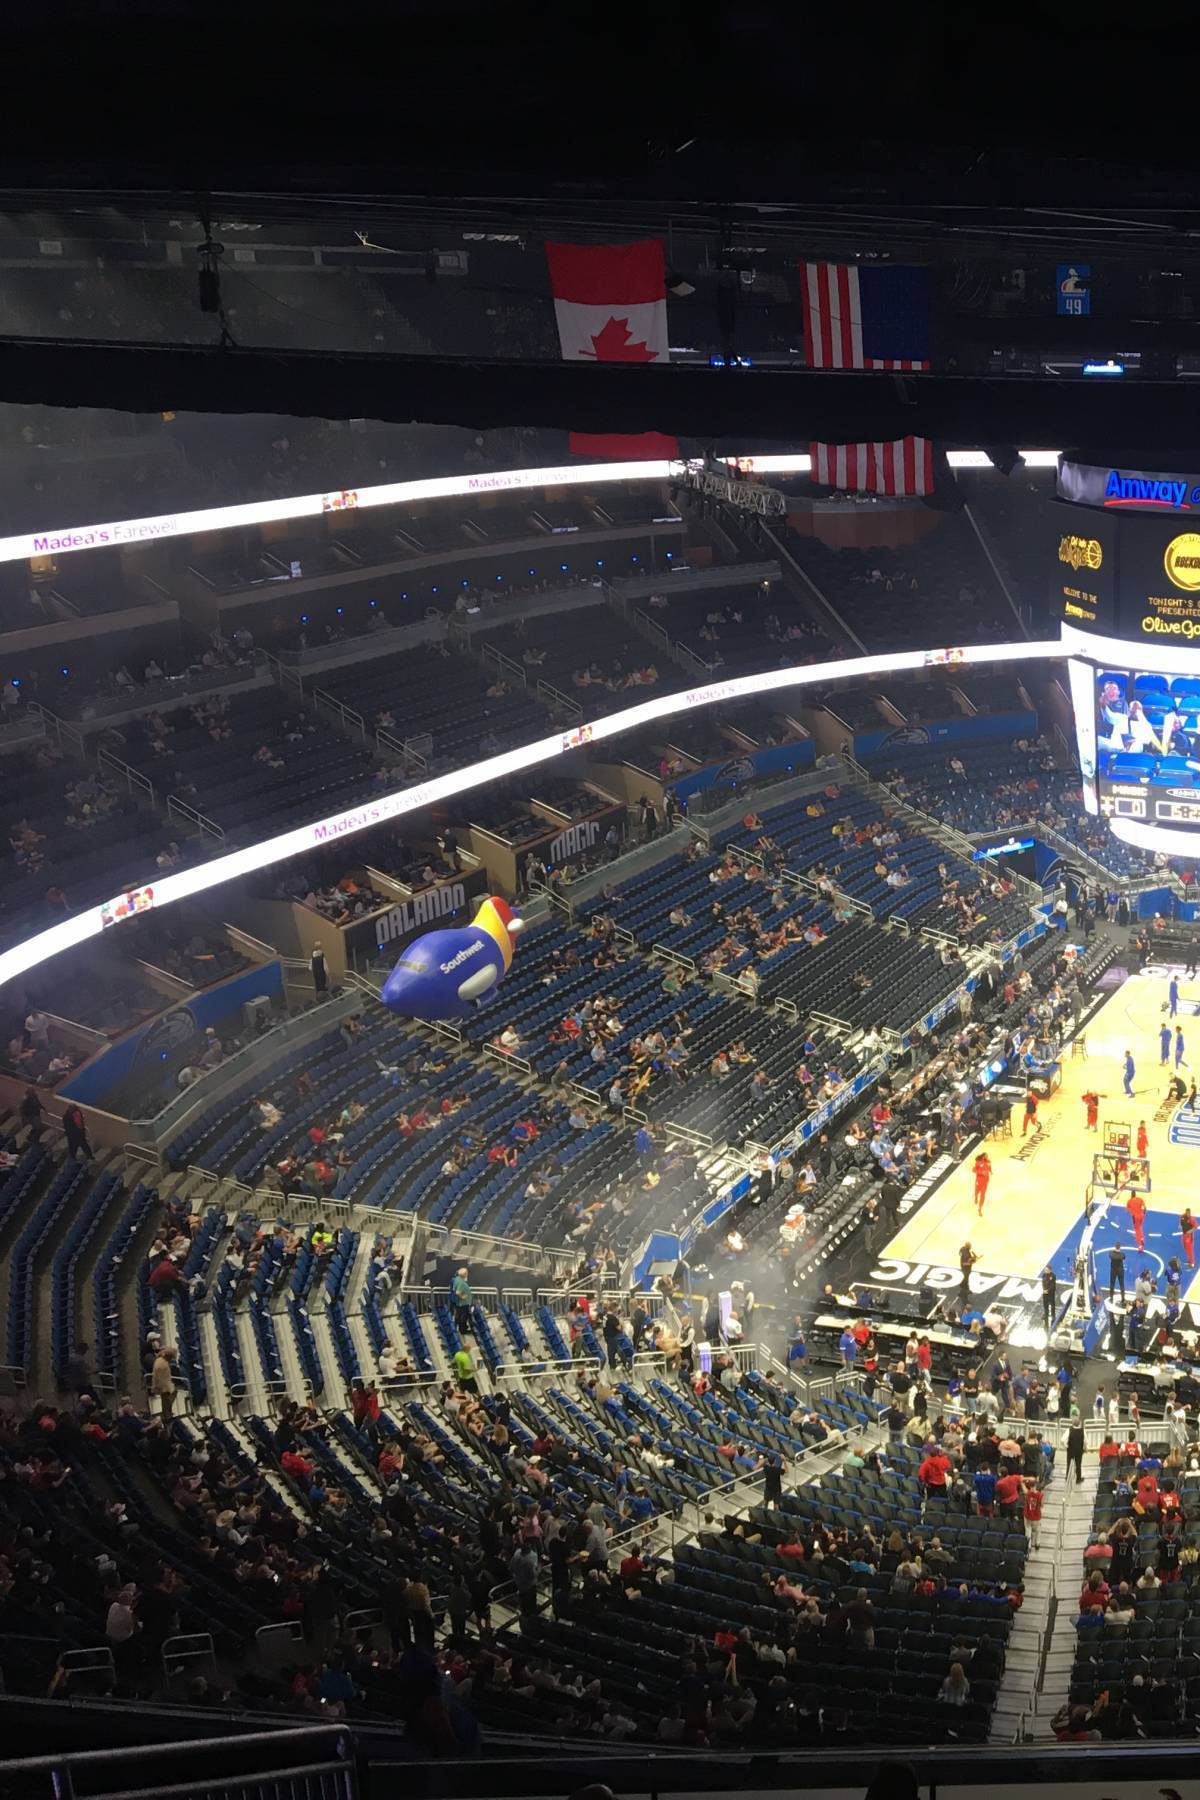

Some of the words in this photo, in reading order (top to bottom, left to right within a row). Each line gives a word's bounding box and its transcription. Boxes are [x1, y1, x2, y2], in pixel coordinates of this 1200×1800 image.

[1106, 471, 1186, 507] Amway
[33, 530, 109, 551] Madea's
[113, 519, 177, 540] Farewell
[1148, 597, 1194, 608] TONIGHT'S
[1142, 616, 1180, 634] Olive
[314, 807, 380, 840] Madea's
[551, 822, 600, 864] MAGIC
[376, 884, 465, 945] ORLANDO
[440, 940, 485, 974] Southwest
[1009, 1128, 1051, 1163] Amway
[870, 1259, 1045, 1304] MAGIC
